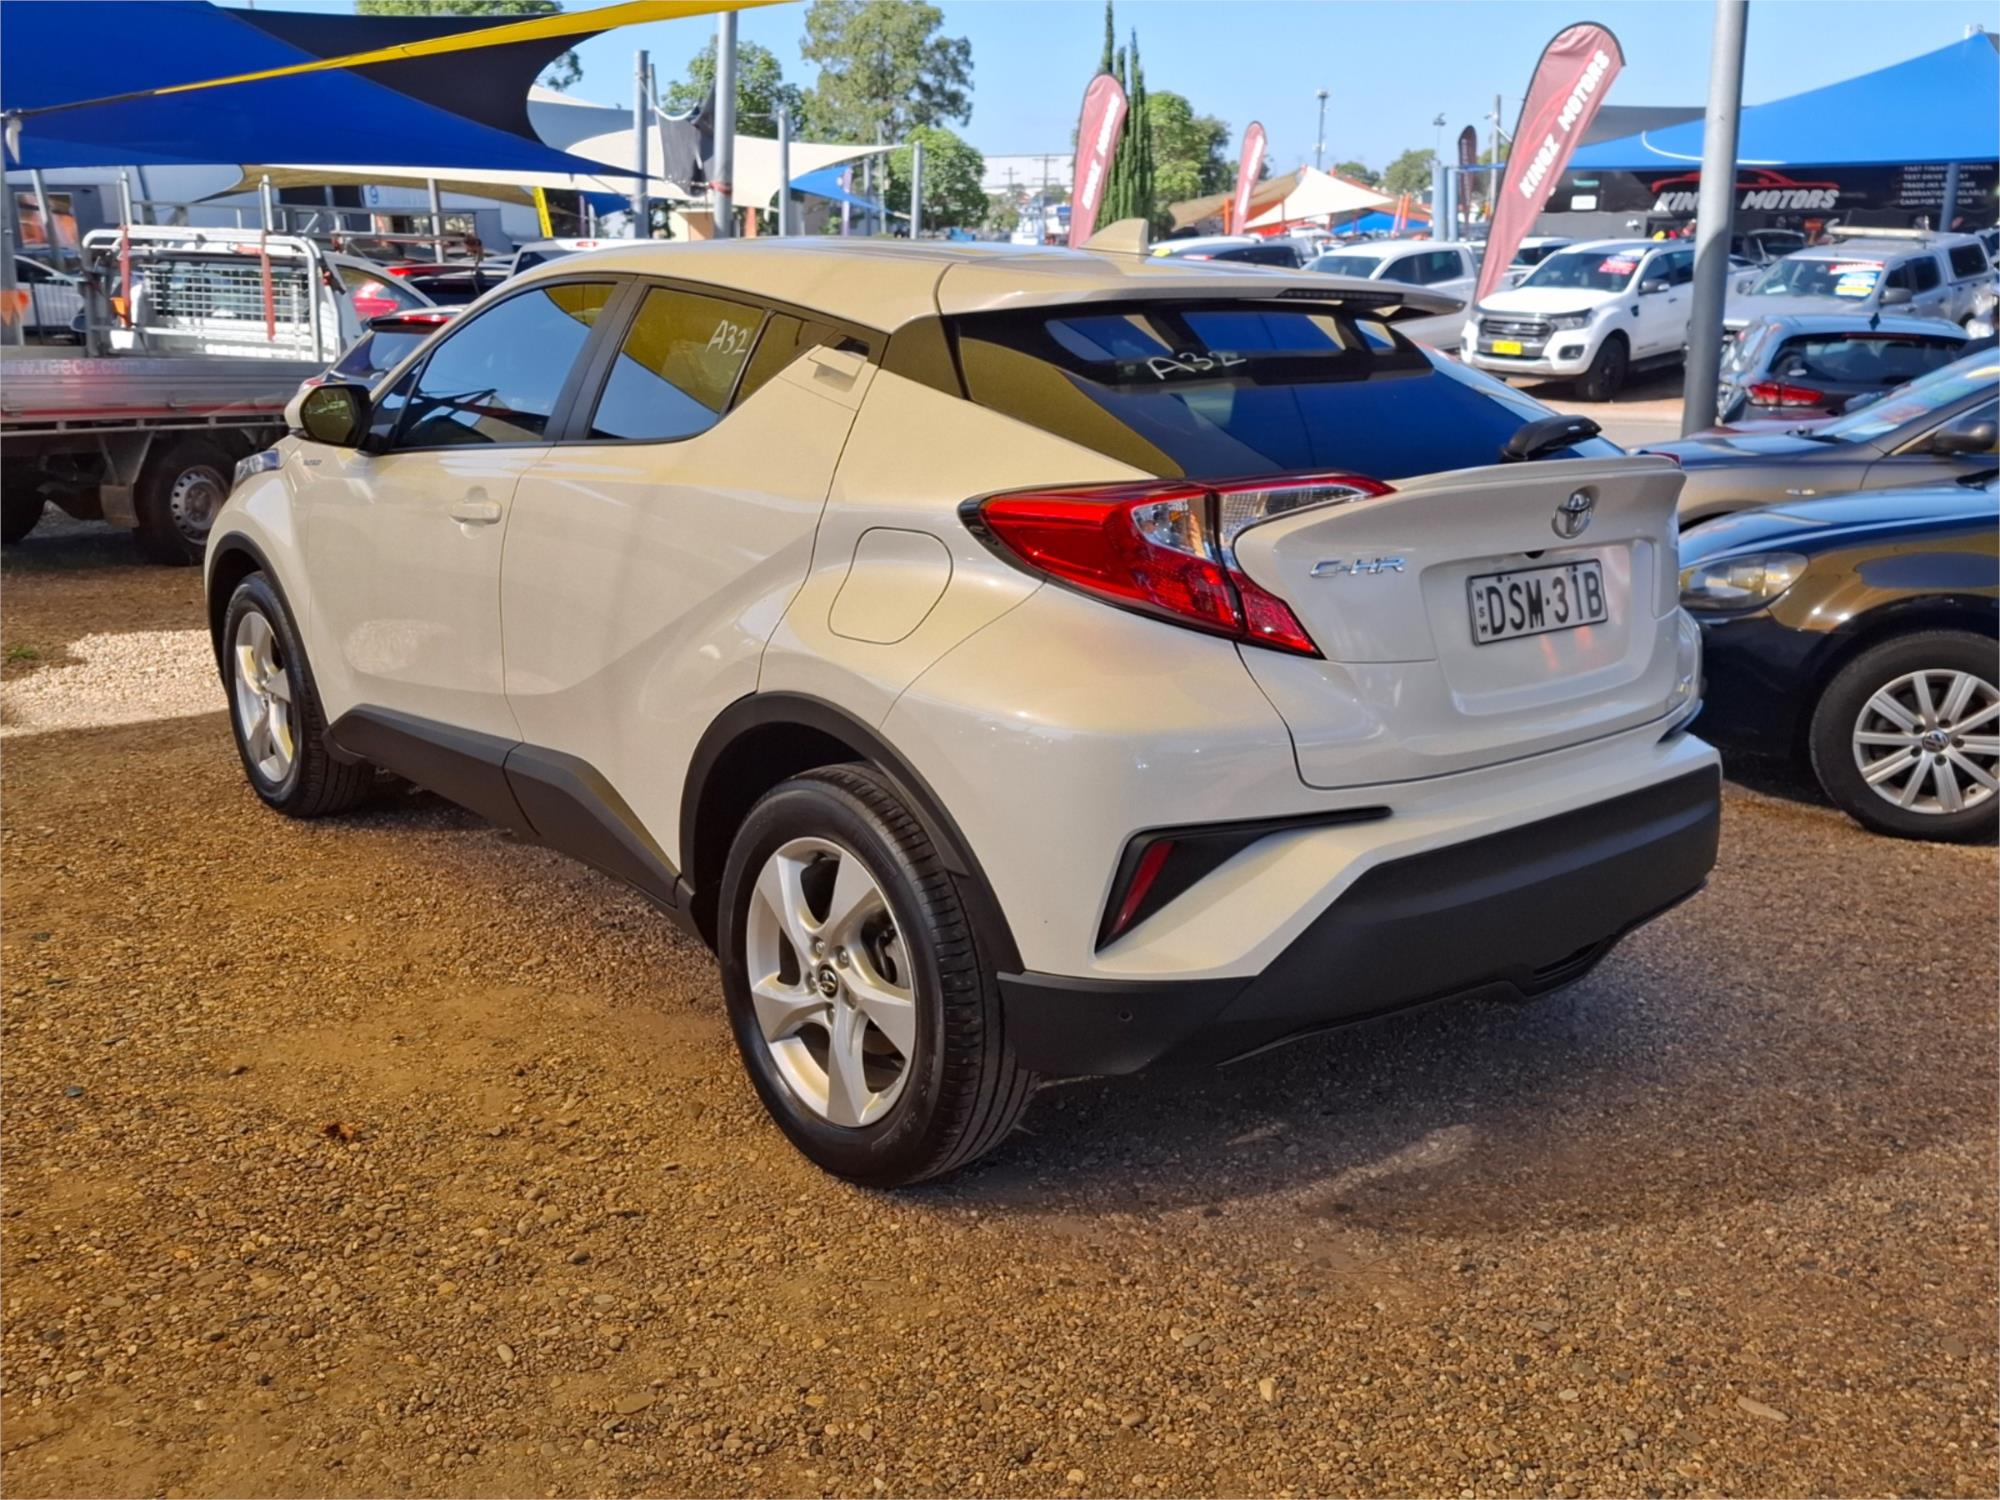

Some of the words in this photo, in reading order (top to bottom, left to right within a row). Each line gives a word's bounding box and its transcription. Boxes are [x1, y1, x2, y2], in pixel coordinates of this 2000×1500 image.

[1557, 49, 1610, 132] MOTORS
[1741, 189, 1840, 210] MOTORS
[705, 319, 748, 356] A32
[1310, 557, 1405, 577] C-HR
